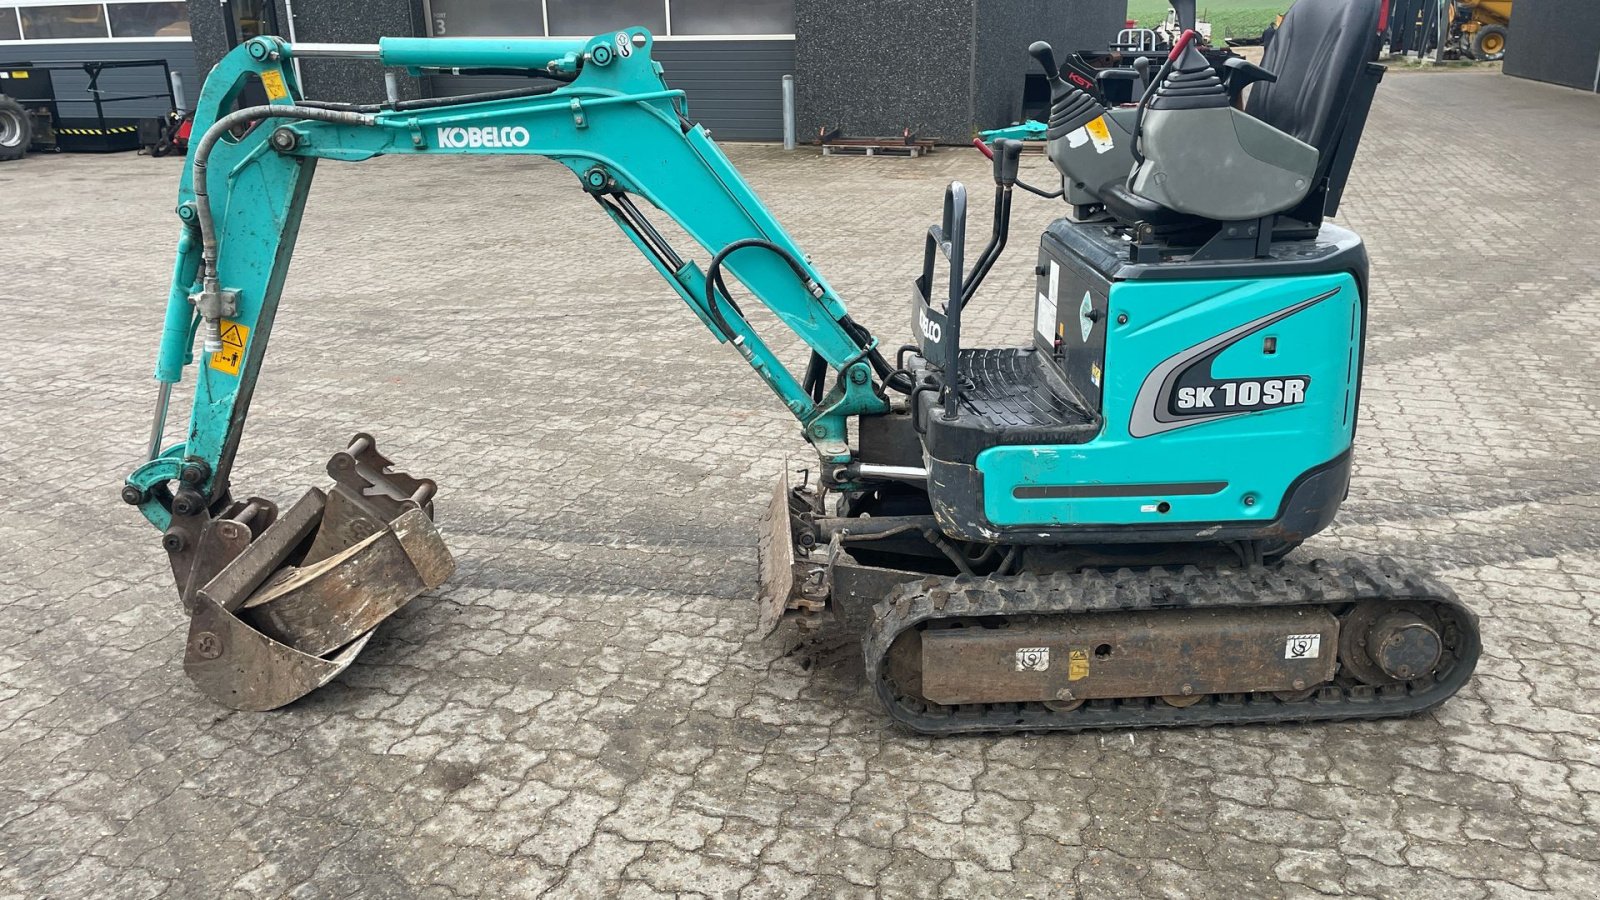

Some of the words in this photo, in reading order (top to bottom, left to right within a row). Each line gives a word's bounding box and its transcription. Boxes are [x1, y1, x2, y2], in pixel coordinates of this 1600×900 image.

[436, 19, 446, 35] 3
[437, 126, 530, 148] KOBELCO
[1177, 386, 1215, 409] SK
[1219, 379, 1305, 406] 10SR
